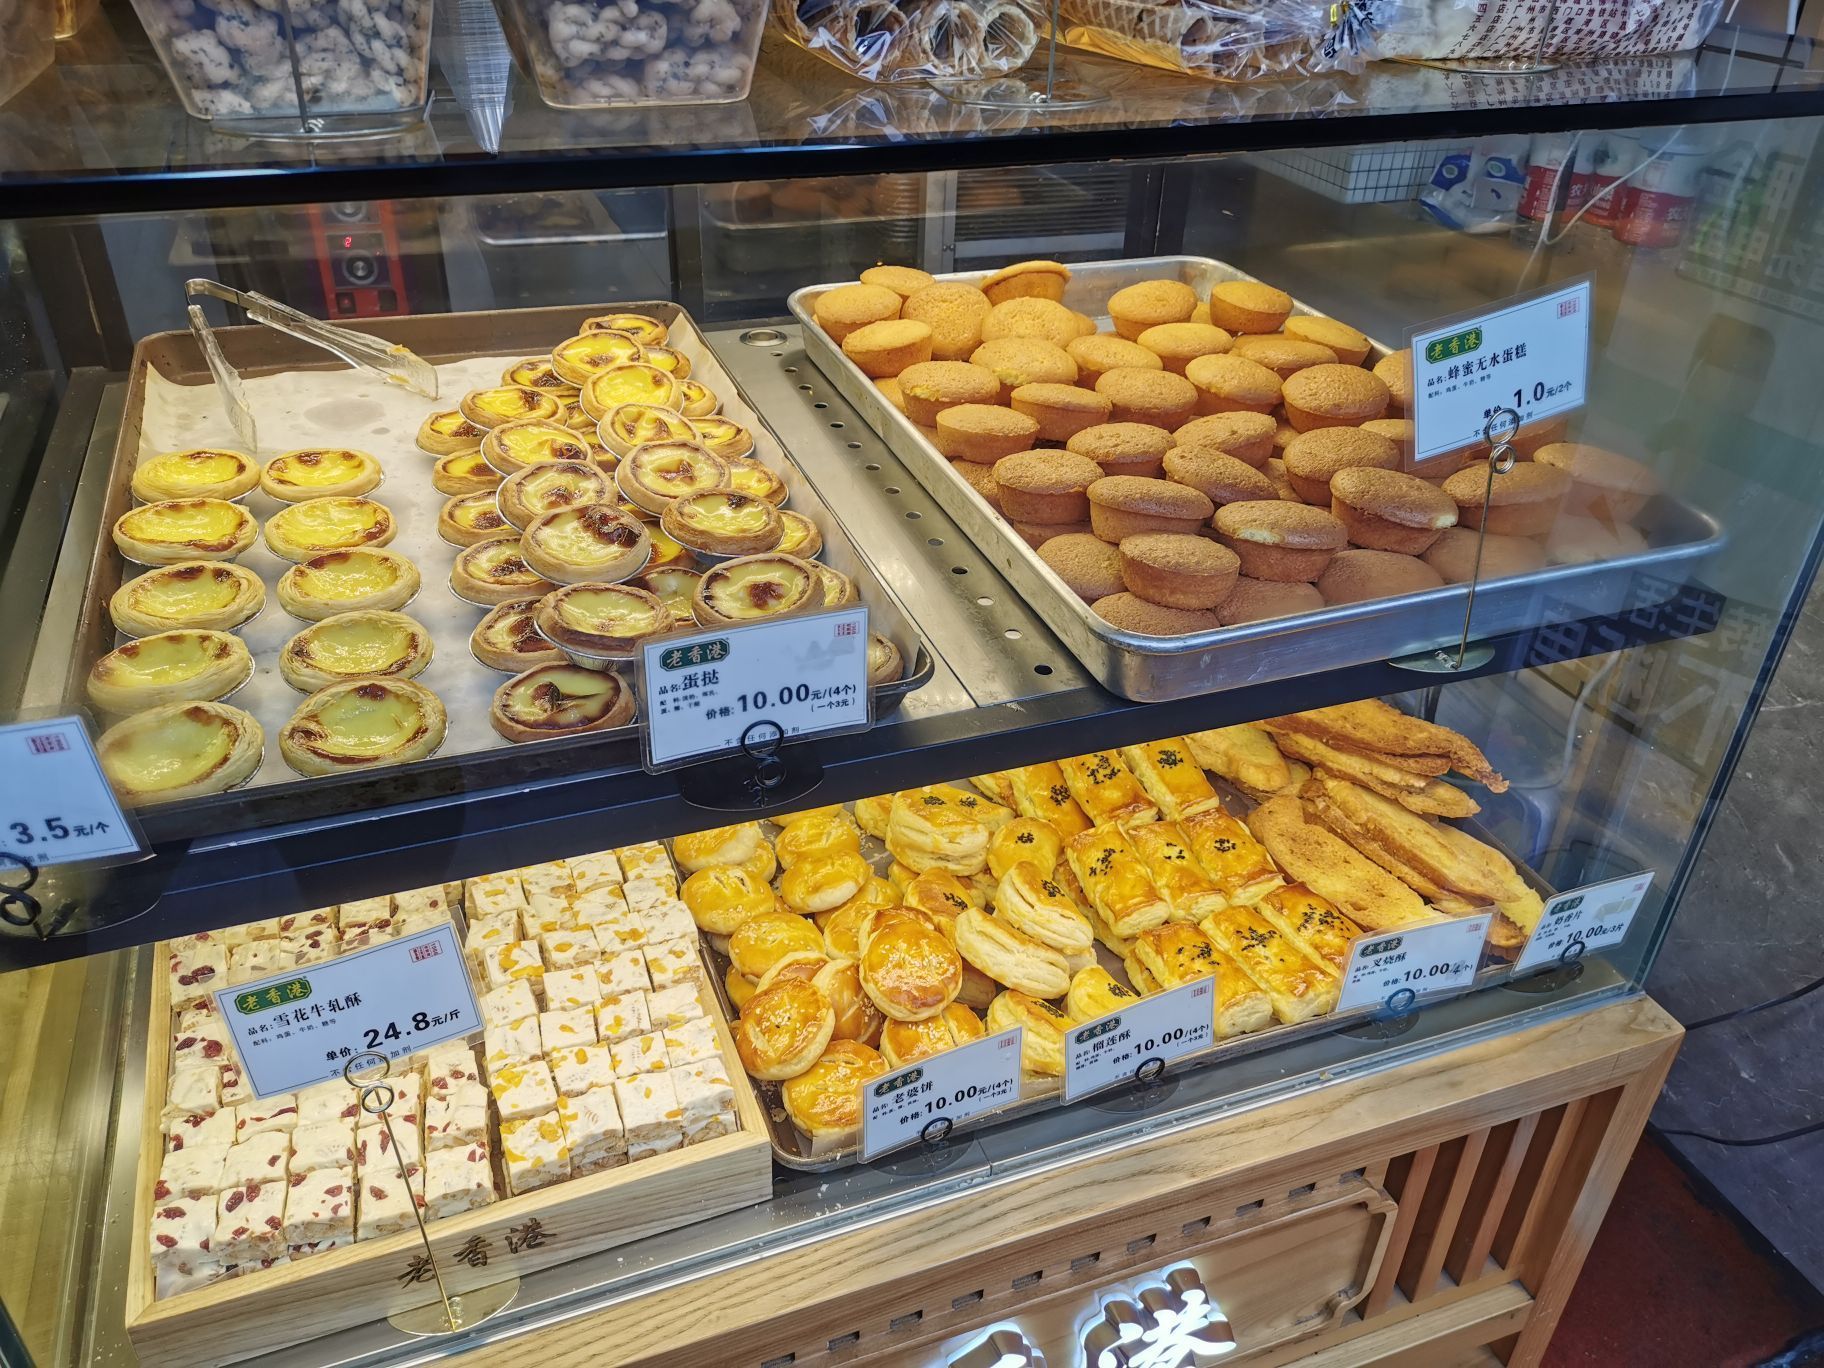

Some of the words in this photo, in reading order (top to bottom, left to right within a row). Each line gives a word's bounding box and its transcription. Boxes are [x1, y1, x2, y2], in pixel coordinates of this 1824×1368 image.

[1430, 331, 1480, 360] 老香港
[666, 641, 727, 668] 老香港
[242, 982, 309, 1011] 老香港
[396, 1217, 558, 1289] 老香港
